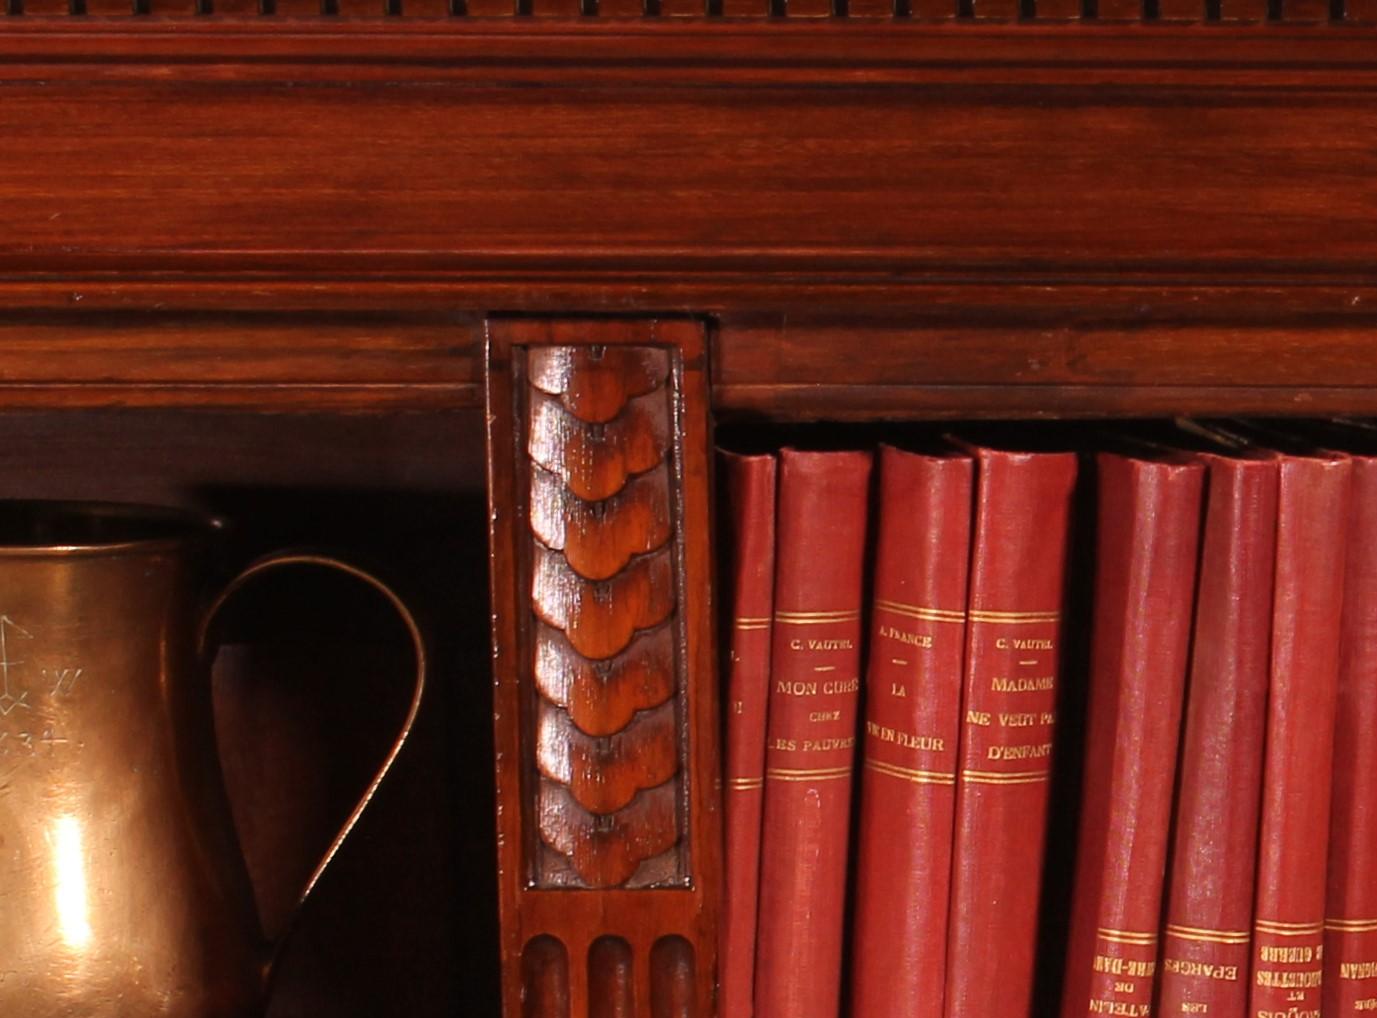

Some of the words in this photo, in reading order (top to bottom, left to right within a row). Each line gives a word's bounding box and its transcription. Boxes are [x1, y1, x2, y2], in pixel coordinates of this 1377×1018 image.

[790, 639, 805, 651] C.
[996, 639, 1010, 650] C.
[1013, 639, 1053, 650] VAUTEL
[776, 680, 818, 697] MON
[892, 683, 907, 697] LA
[991, 679, 1054, 693] MADAME
[966, 710, 992, 727] NE
[999, 713, 1037, 728] VEUT
[898, 733, 945, 752] FLEUR
[987, 743, 1053, 761] D'ENFANT
[1181, 1003, 1208, 1014] LES
